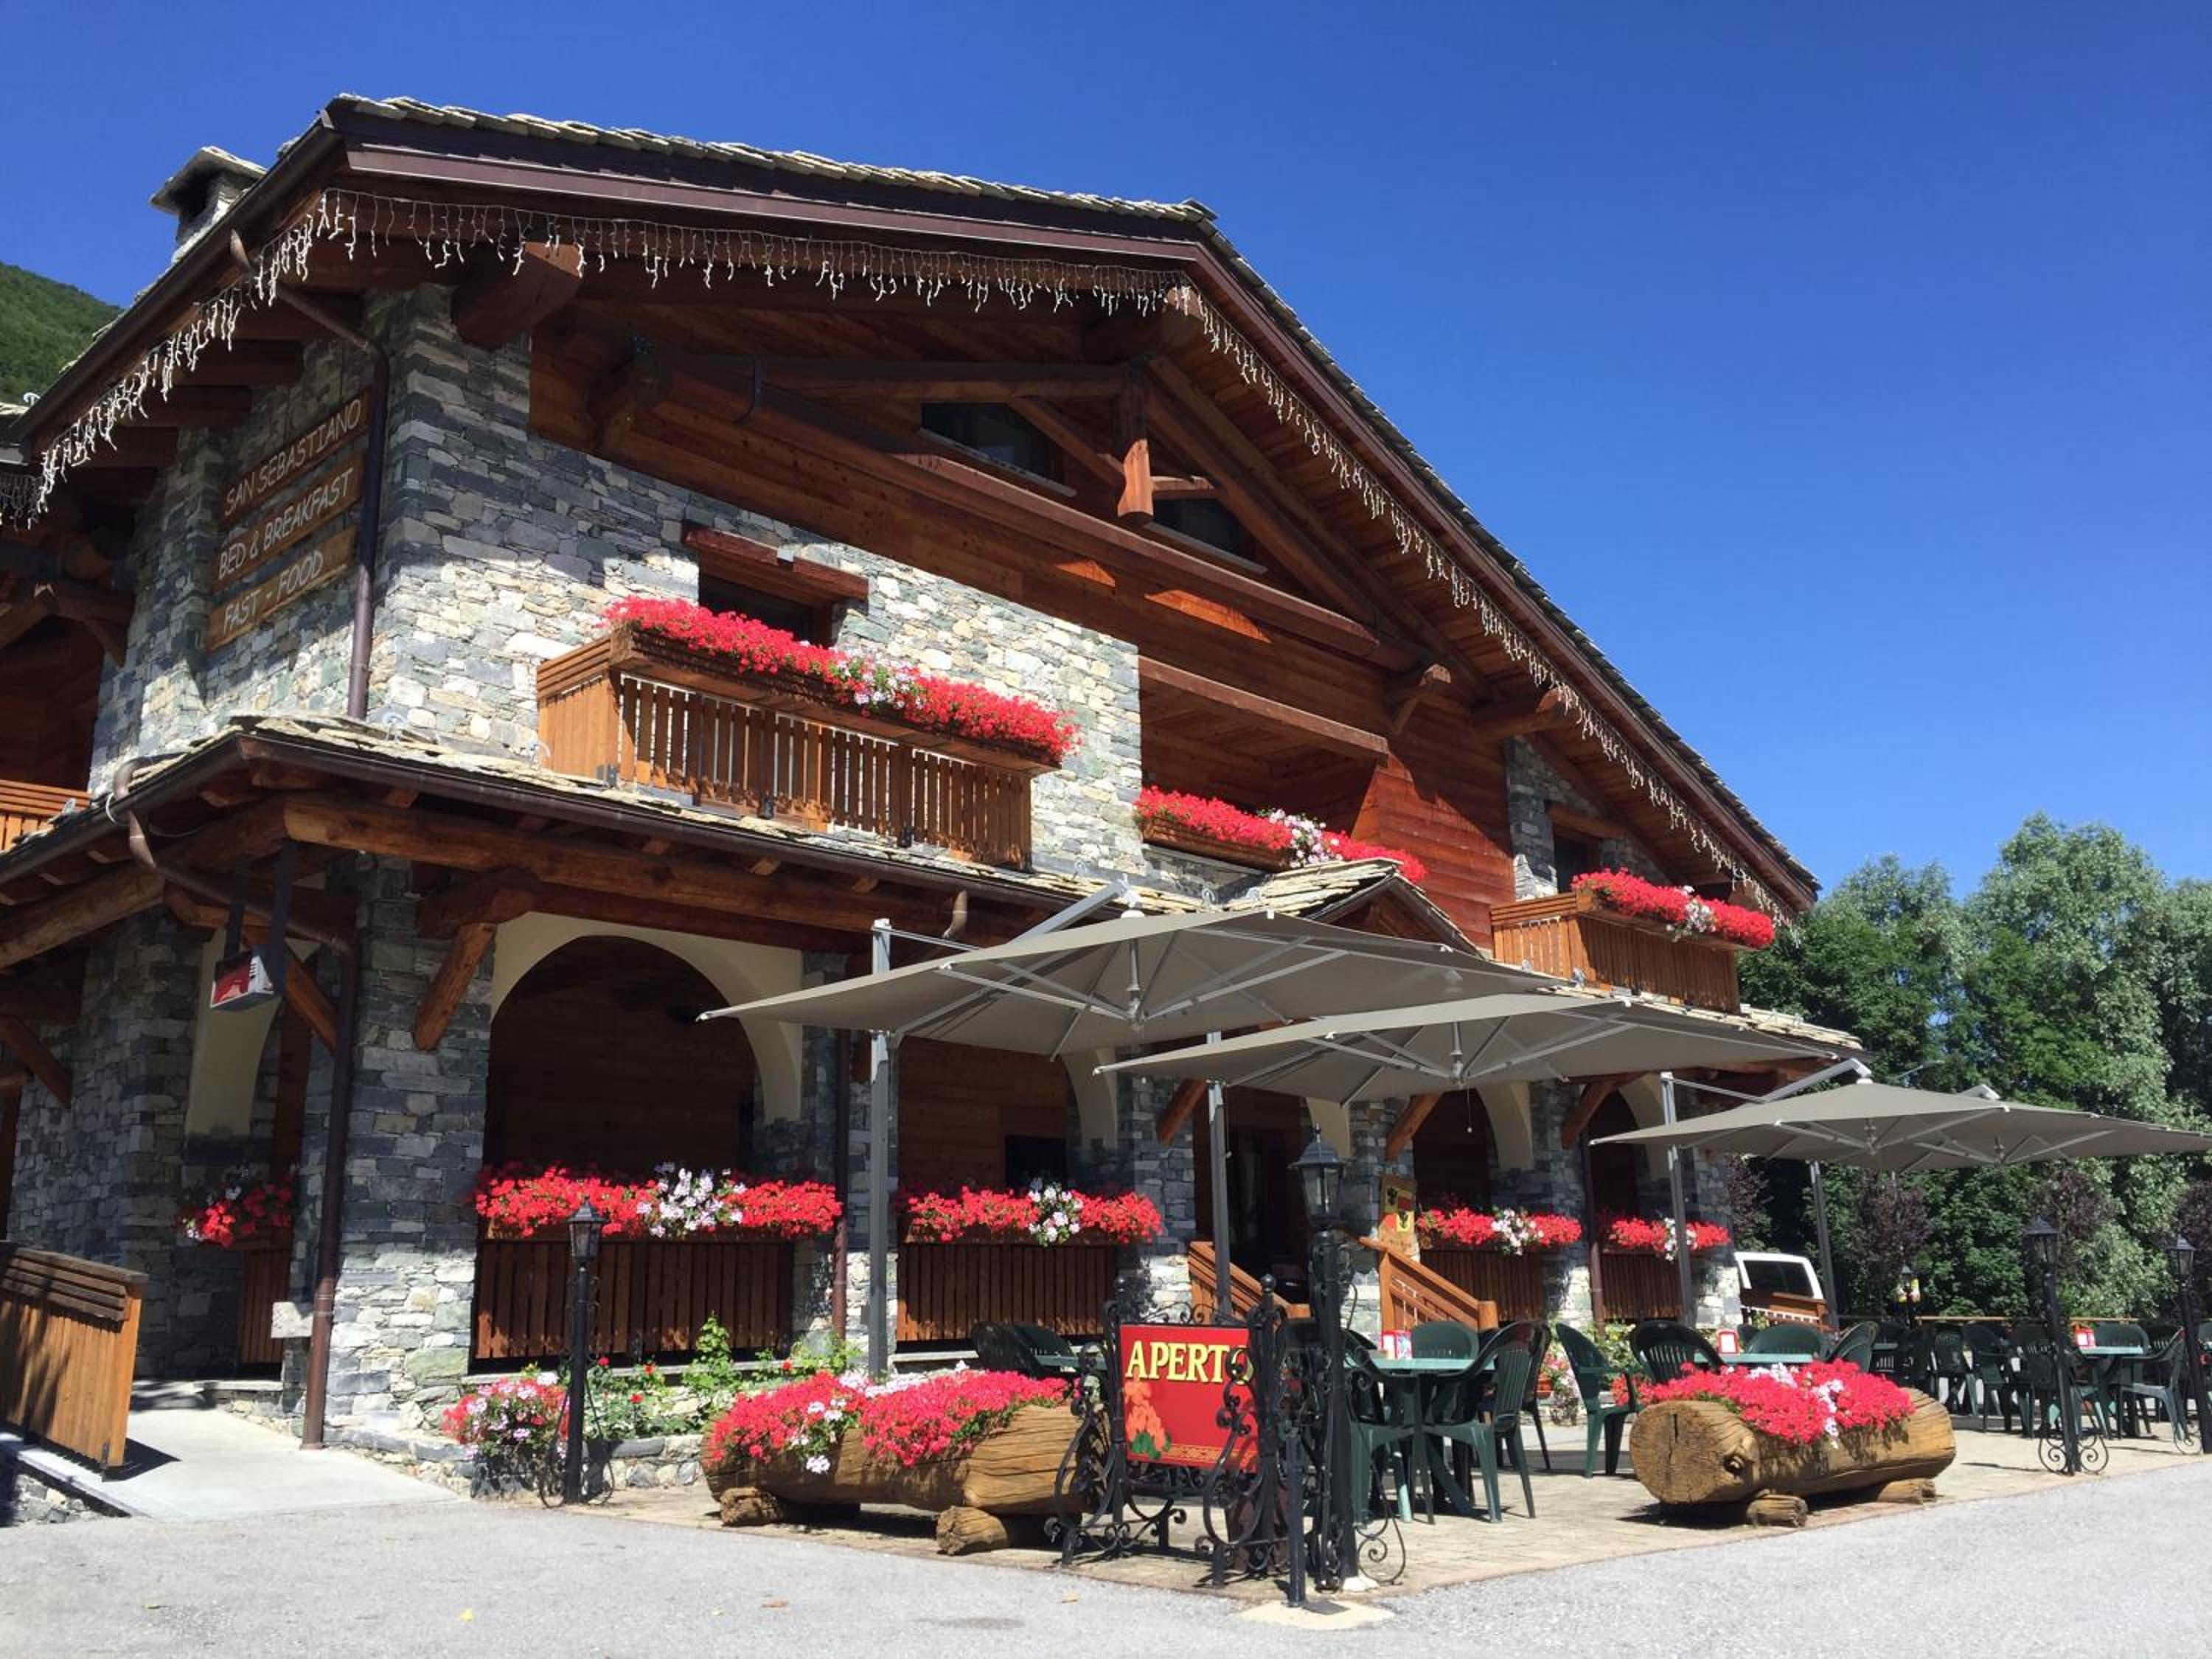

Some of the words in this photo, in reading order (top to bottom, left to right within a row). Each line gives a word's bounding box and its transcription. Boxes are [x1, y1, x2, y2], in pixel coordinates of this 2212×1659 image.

[225, 472, 255, 516] SAN
[257, 400, 361, 493] SEBASTIANO
[218, 542, 246, 580] BED
[249, 530, 260, 557] &
[263, 467, 354, 552] BREAKFAST
[223, 589, 261, 633] FAST
[277, 551, 324, 602] FOOD
